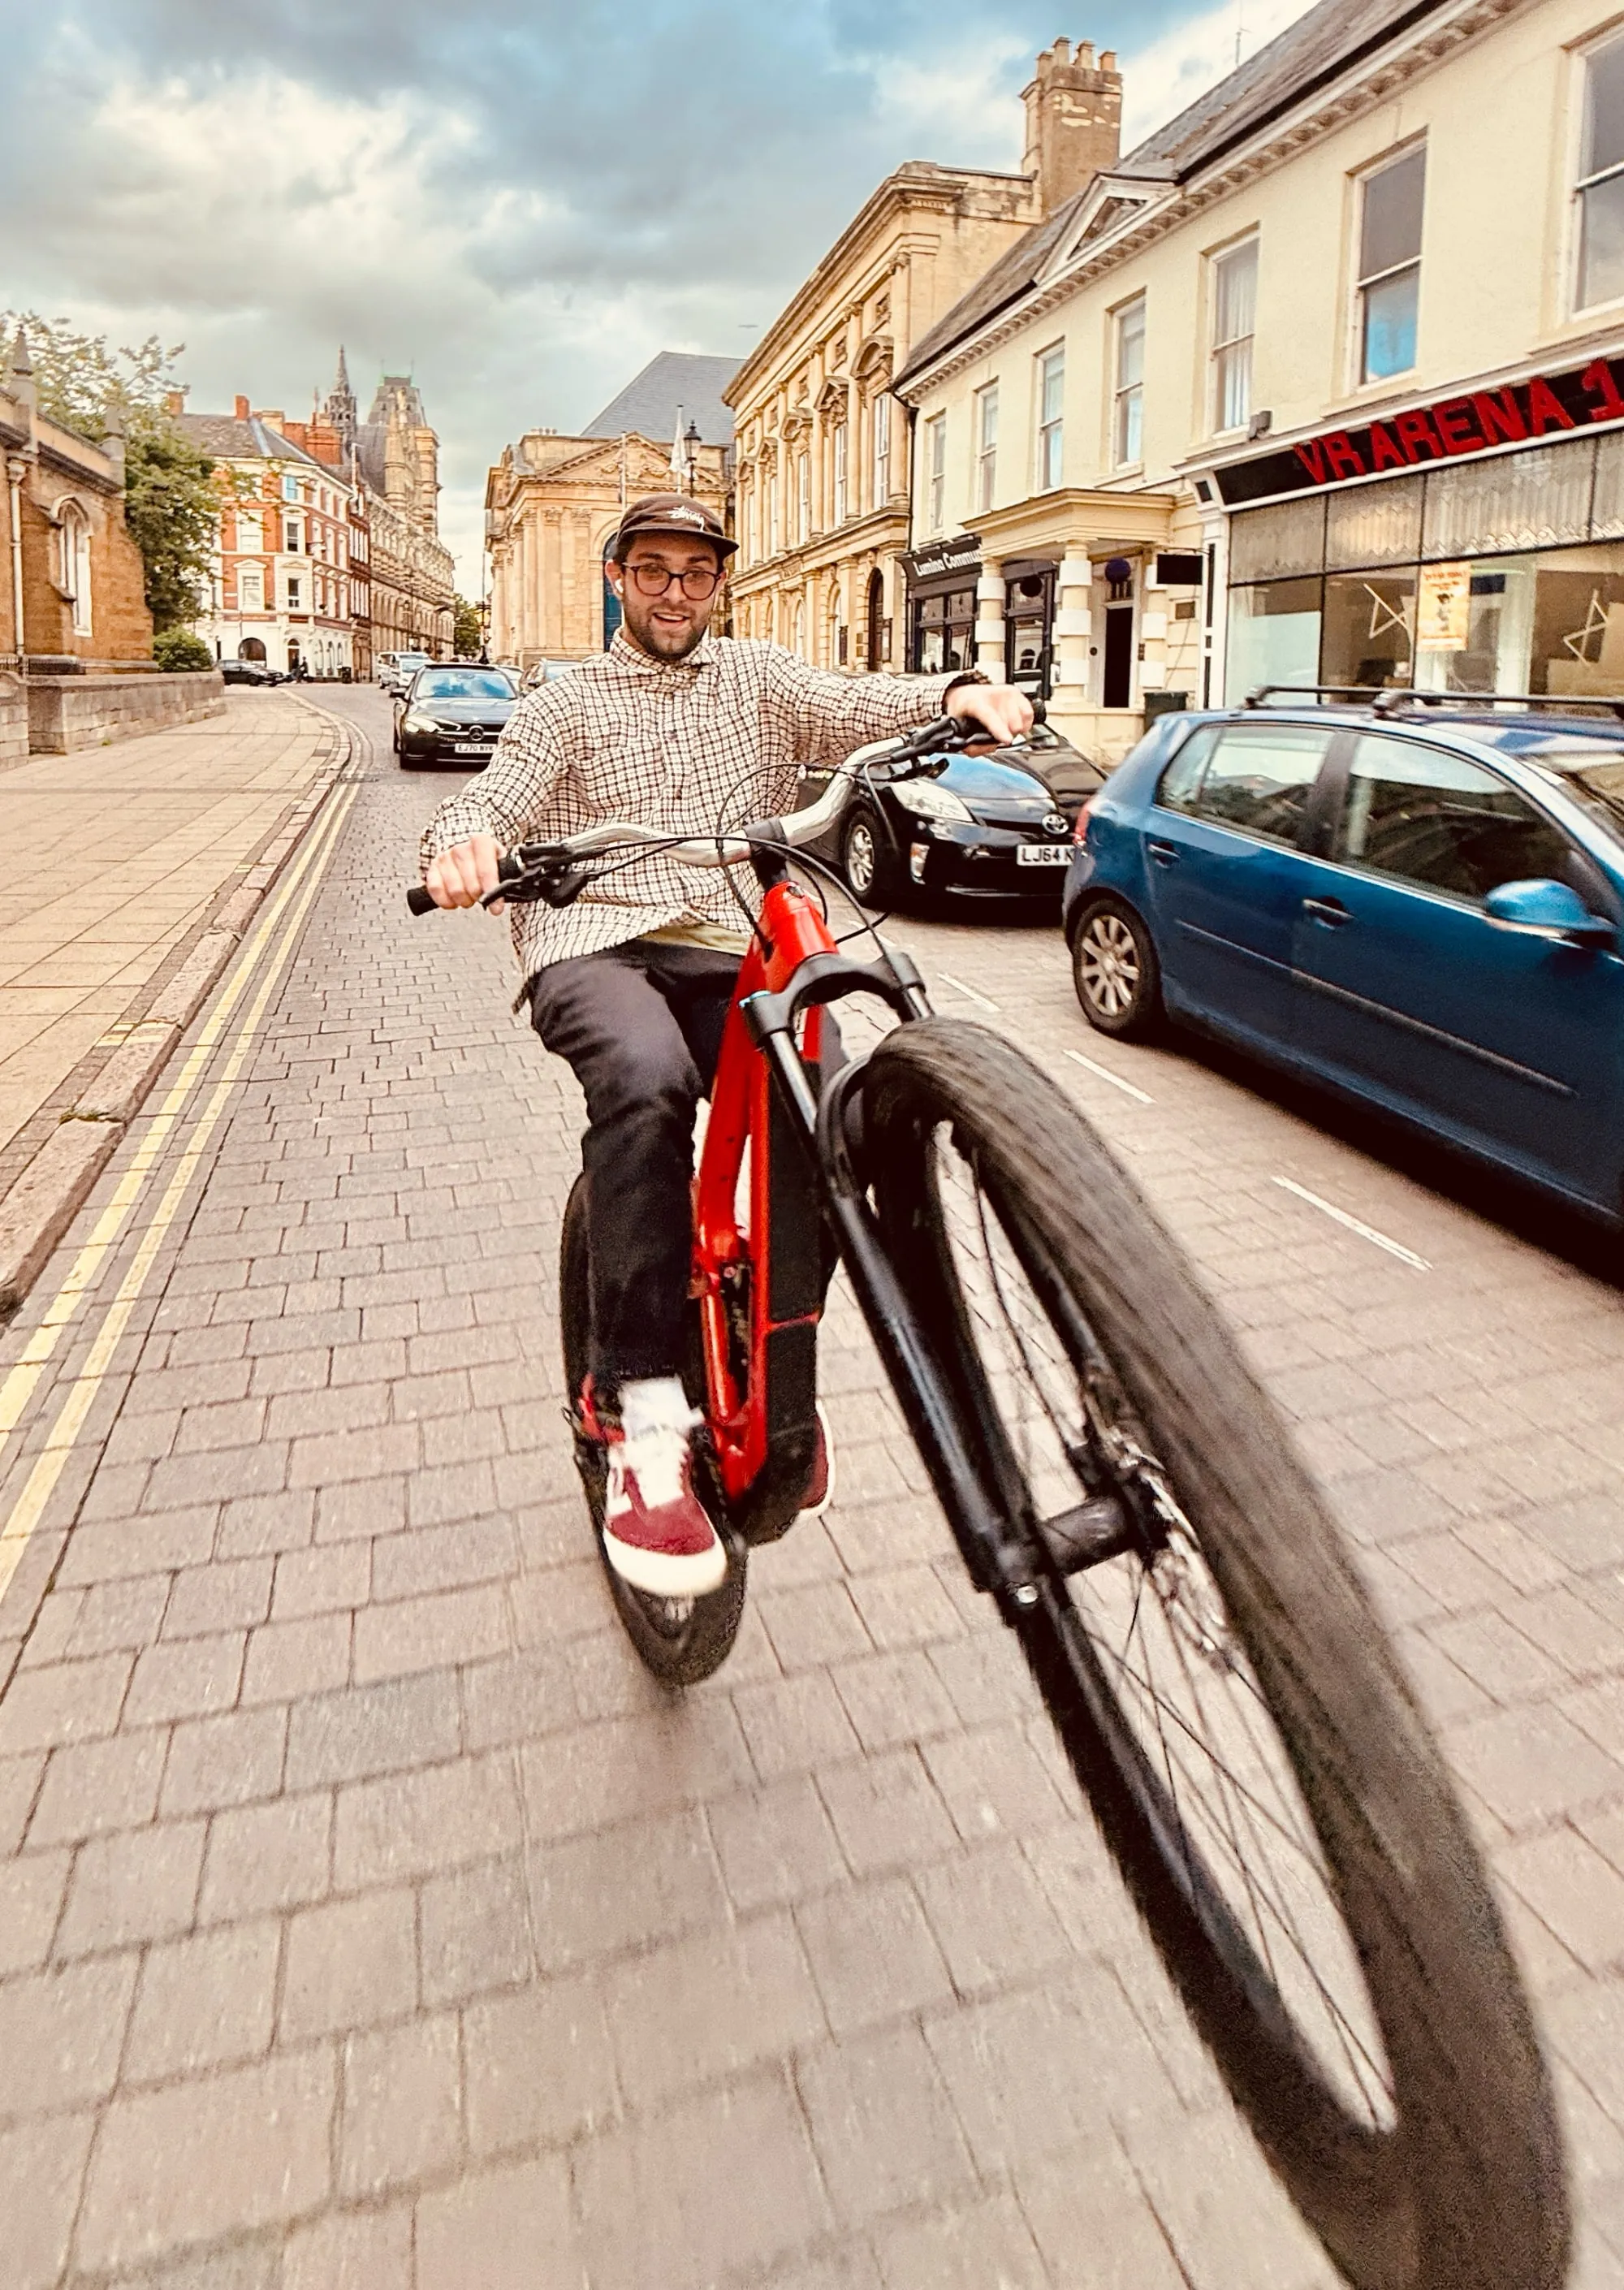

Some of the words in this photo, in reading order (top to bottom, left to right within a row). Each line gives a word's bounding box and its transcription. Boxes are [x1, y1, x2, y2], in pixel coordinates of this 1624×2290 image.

[1293, 430, 1366, 485] VR
[1370, 377, 1575, 473] ARENA
[1021, 847, 1060, 862] LJ64
